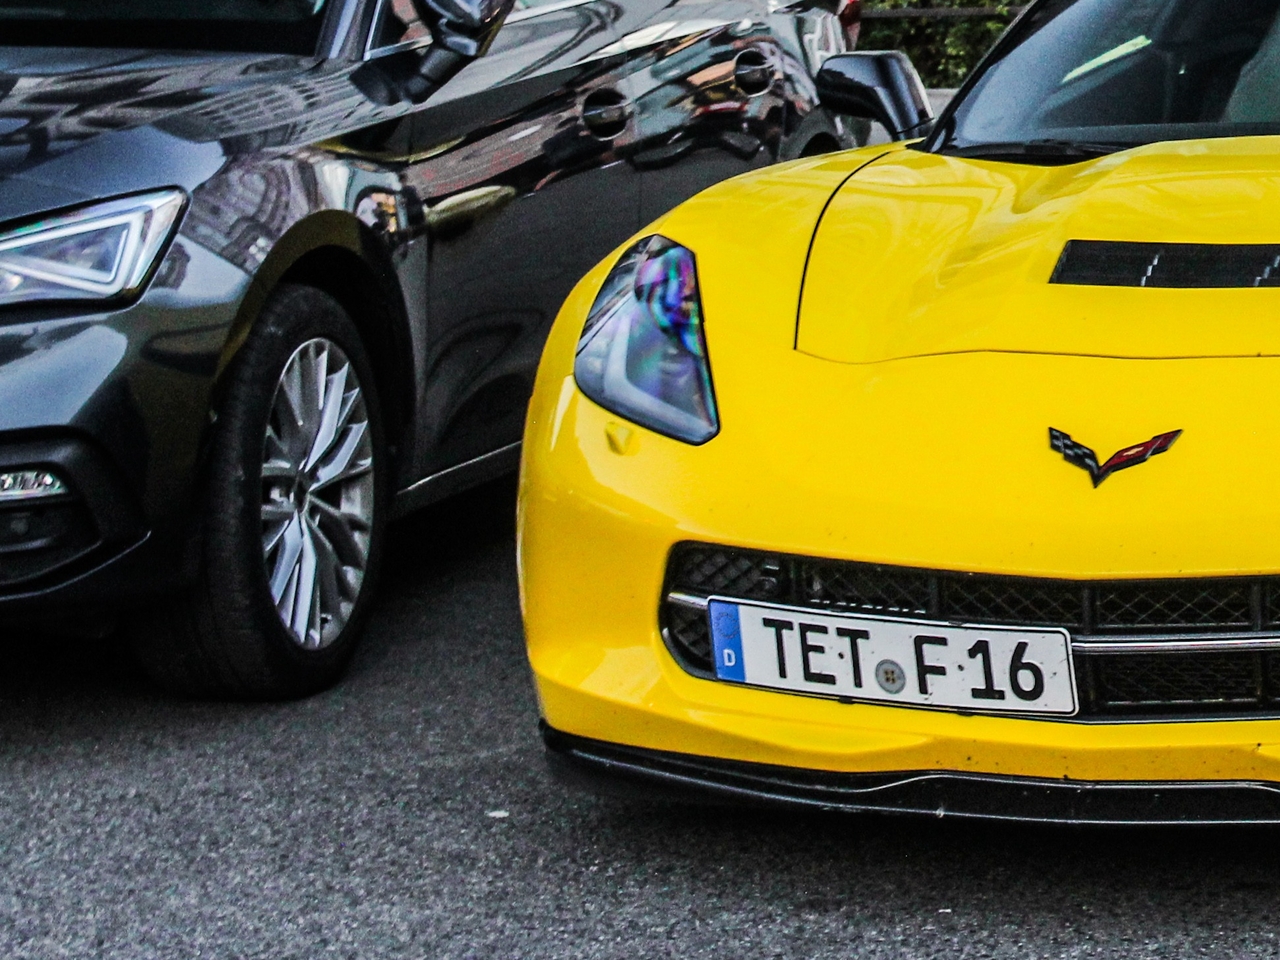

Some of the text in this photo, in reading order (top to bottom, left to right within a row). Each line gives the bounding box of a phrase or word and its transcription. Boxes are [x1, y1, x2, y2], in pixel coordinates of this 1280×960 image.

[723, 649, 736, 667] D
[762, 617, 1045, 702] TET F 16
